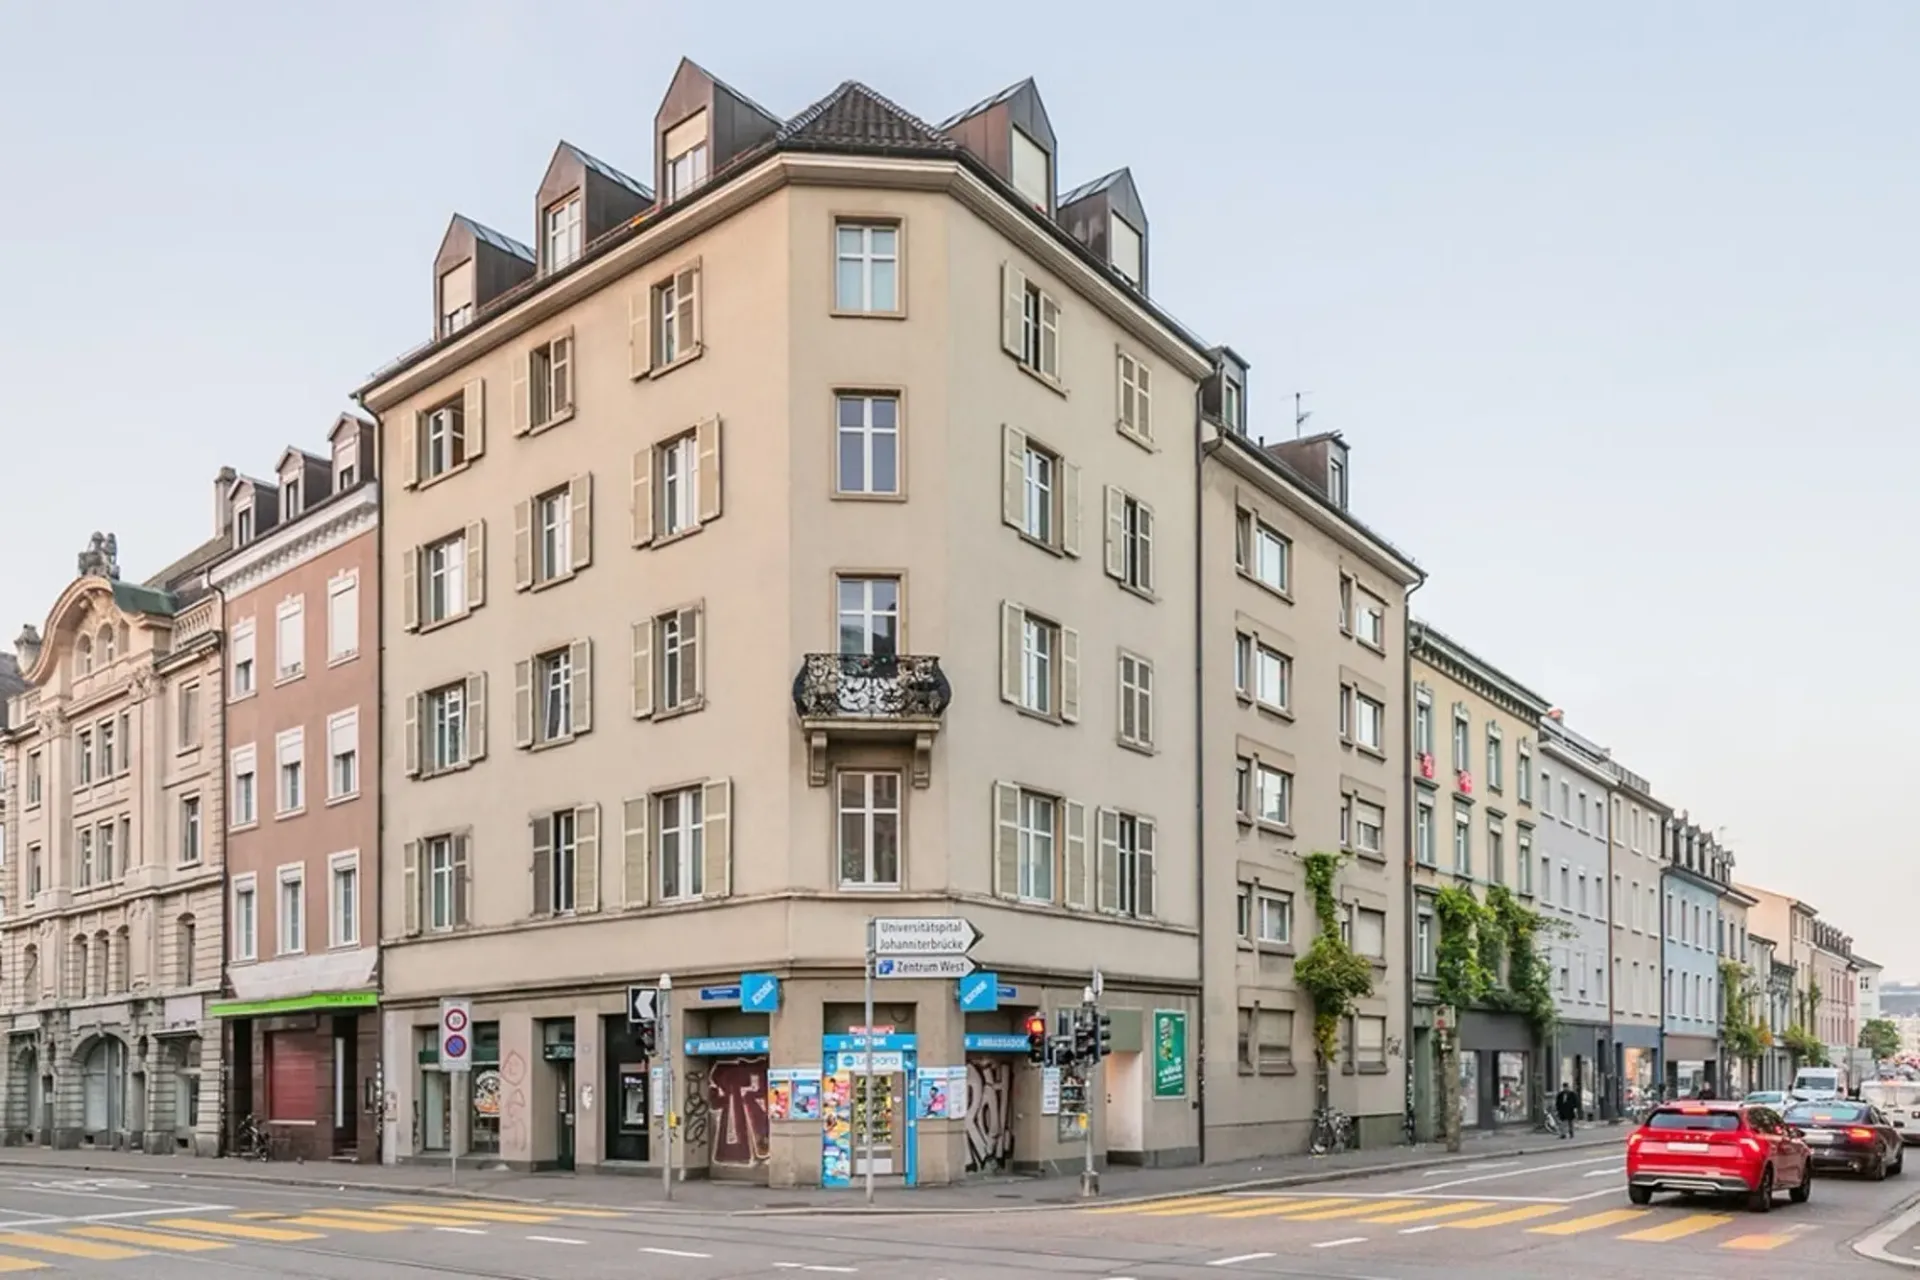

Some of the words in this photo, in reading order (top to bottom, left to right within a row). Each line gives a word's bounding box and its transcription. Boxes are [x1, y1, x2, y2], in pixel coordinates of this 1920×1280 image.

[881, 922, 962, 935] Universitätspital
[880, 938, 964, 950] Johanniterbrücke
[896, 961, 939, 973] Zentrum
[940, 961, 964, 972] West
